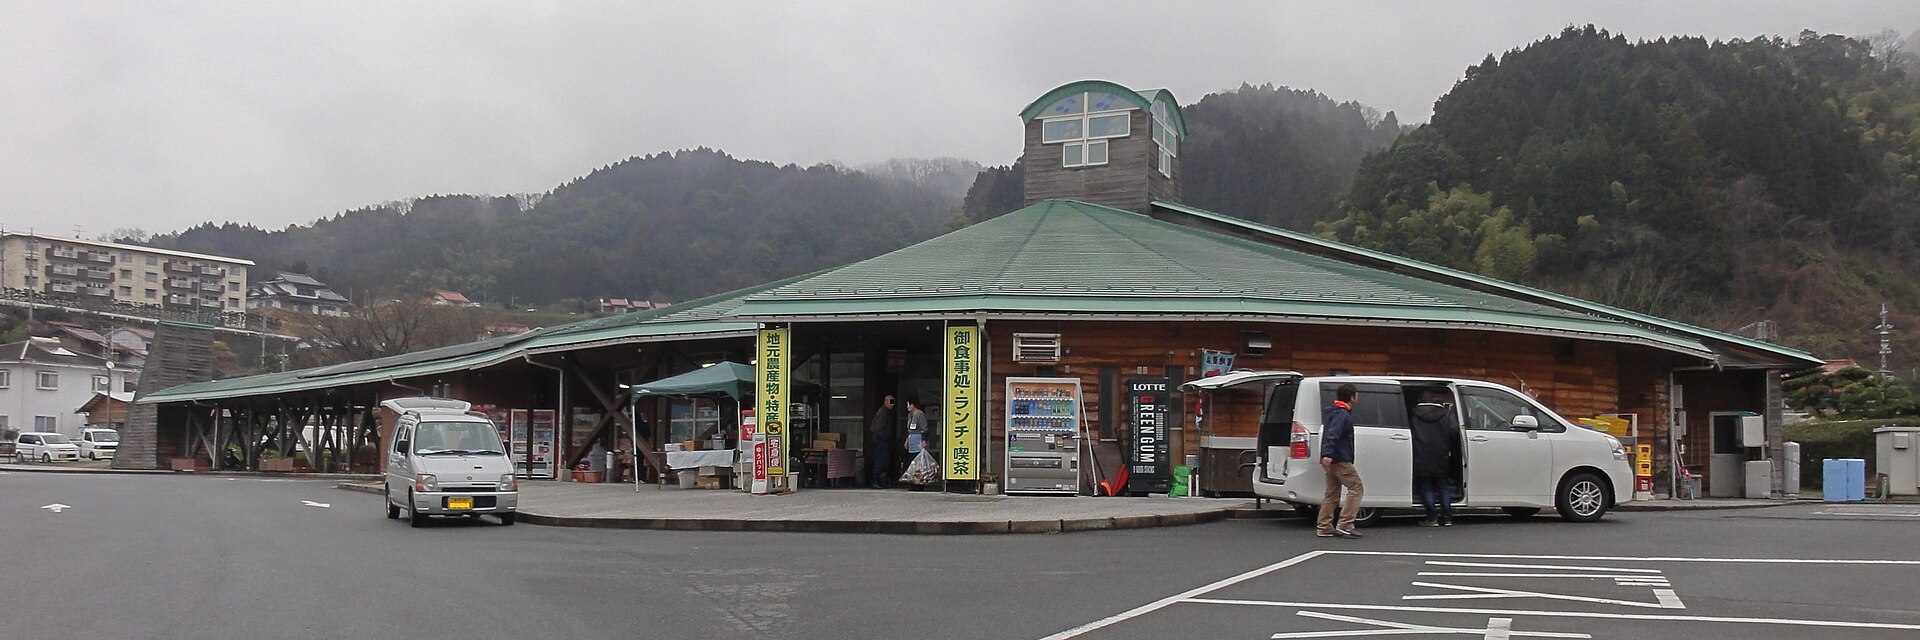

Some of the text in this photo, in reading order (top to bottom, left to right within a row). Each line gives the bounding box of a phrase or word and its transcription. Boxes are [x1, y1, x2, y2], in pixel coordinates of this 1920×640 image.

[954, 331, 970, 475] 御食事処・ランチ・喫茶
[1133, 383, 1166, 391] LOTTE
[1139, 395, 1155, 434] GREEN
[1139, 437, 1155, 463] GUM
